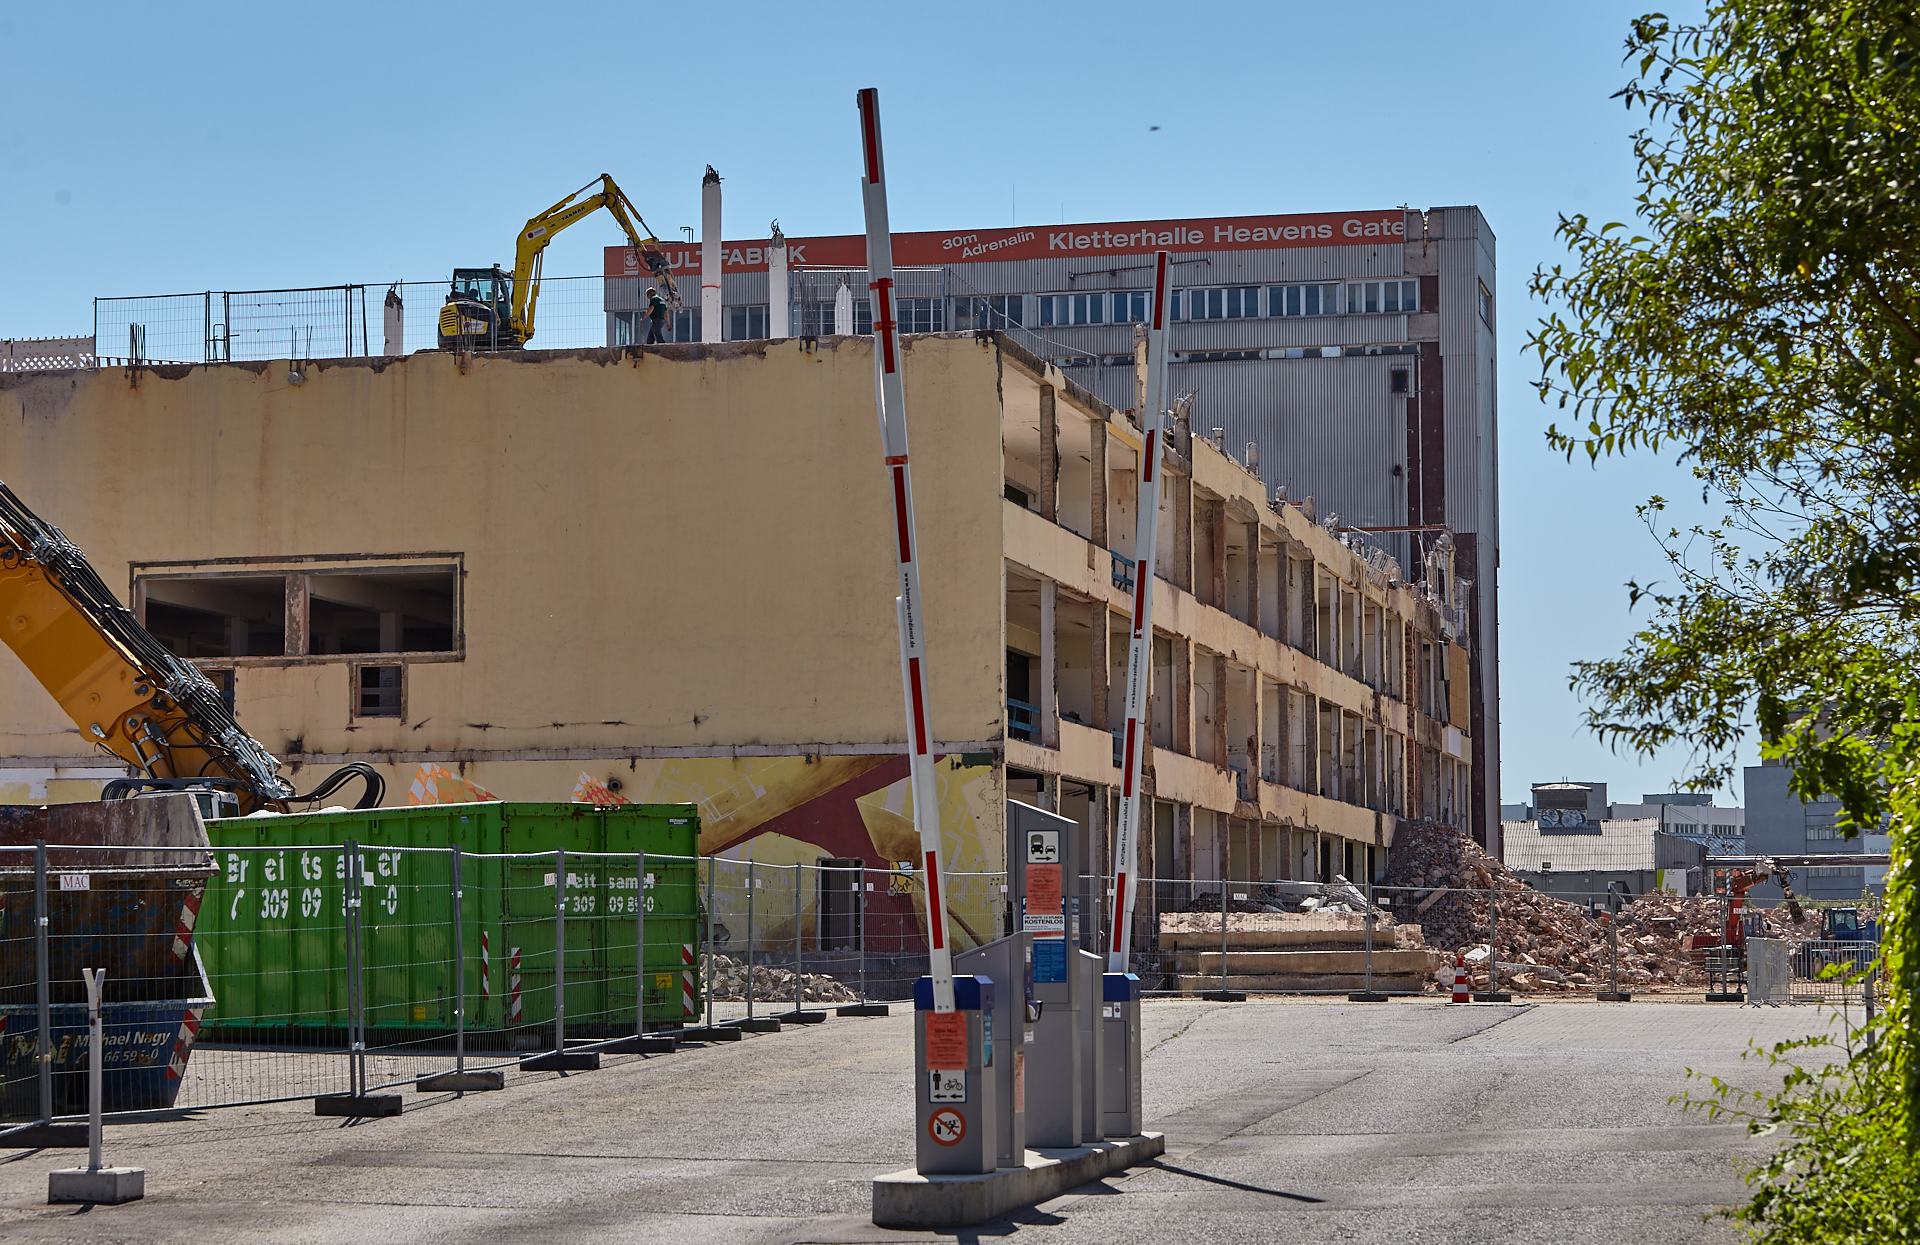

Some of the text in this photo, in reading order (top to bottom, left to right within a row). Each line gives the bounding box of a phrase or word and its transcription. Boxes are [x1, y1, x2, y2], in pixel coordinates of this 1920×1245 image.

[561, 206, 586, 221] YANMAR
[1049, 217, 1404, 250] Kletterhalle Heavens Gate
[942, 234, 978, 250] 30m
[962, 231, 1035, 259] Adrenalin
[63, 875, 88, 888] MAC
[261, 888, 289, 919] 309
[301, 887, 322, 919] 09
[573, 896, 596, 912] 309
[609, 896, 624, 912] 09
[74, 1031, 171, 1048] Mhael Nagy
[104, 1051, 120, 1063] 66
